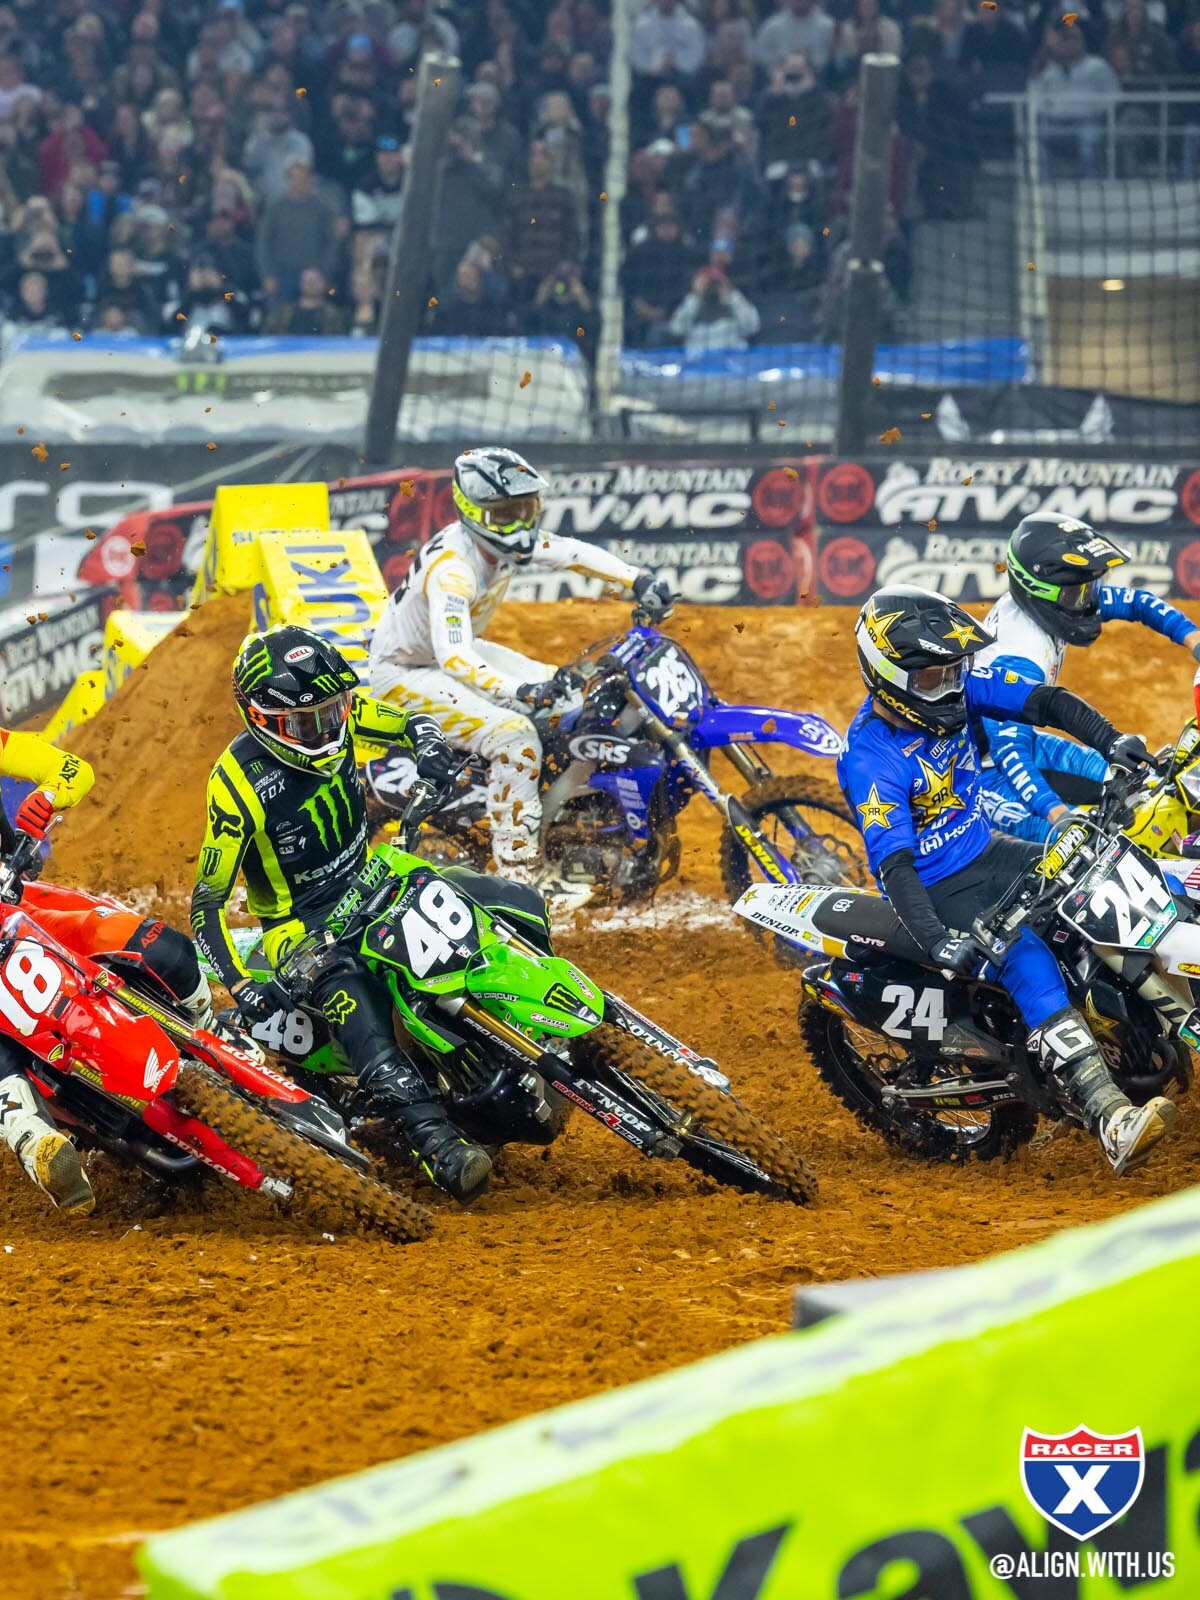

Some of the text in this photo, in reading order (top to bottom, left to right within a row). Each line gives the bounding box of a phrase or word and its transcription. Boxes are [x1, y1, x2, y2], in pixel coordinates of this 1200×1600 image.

[1017, 458, 1178, 488] MOUNTAIN
[288, 647, 311, 661] BELL
[260, 779, 286, 804] FOX
[1090, 850, 1172, 946] 24
[400, 879, 474, 980] 48
[849, 933, 887, 949] GUTS
[239, 986, 264, 1007] FOX
[880, 984, 948, 1041] 24
[251, 1008, 314, 1056] 48
[463, 1016, 539, 1068] PRO CIRCUIT
[150, 1059, 176, 1094] HONDA
[551, 1079, 597, 1114] BRAKING
[161, 1130, 242, 1184] DUNLOP
